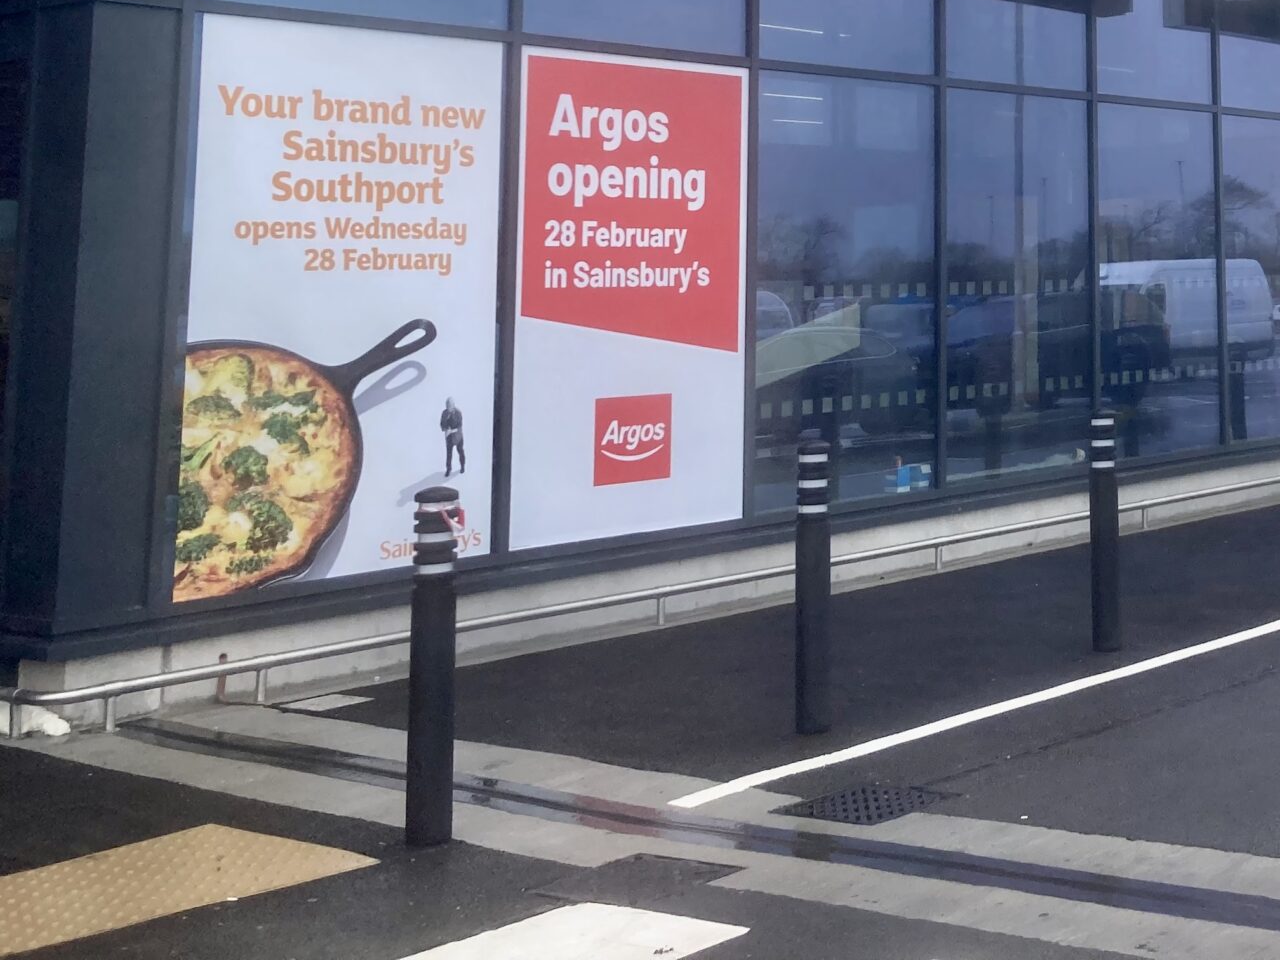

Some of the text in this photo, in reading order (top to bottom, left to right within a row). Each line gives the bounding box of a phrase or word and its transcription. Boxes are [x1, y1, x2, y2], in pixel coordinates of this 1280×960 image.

[218, 85, 486, 130] Your brand new
[549, 93, 669, 151] Argos
[283, 131, 475, 174] Sainsbury's
[271, 171, 444, 210] Southport
[548, 156, 706, 211] opening
[235, 216, 467, 245] opens Wednesday
[545, 220, 686, 254] 28 February
[304, 249, 451, 275] 28 February
[545, 262, 710, 293] in Sainsbury's
[601, 420, 665, 450] Argos
